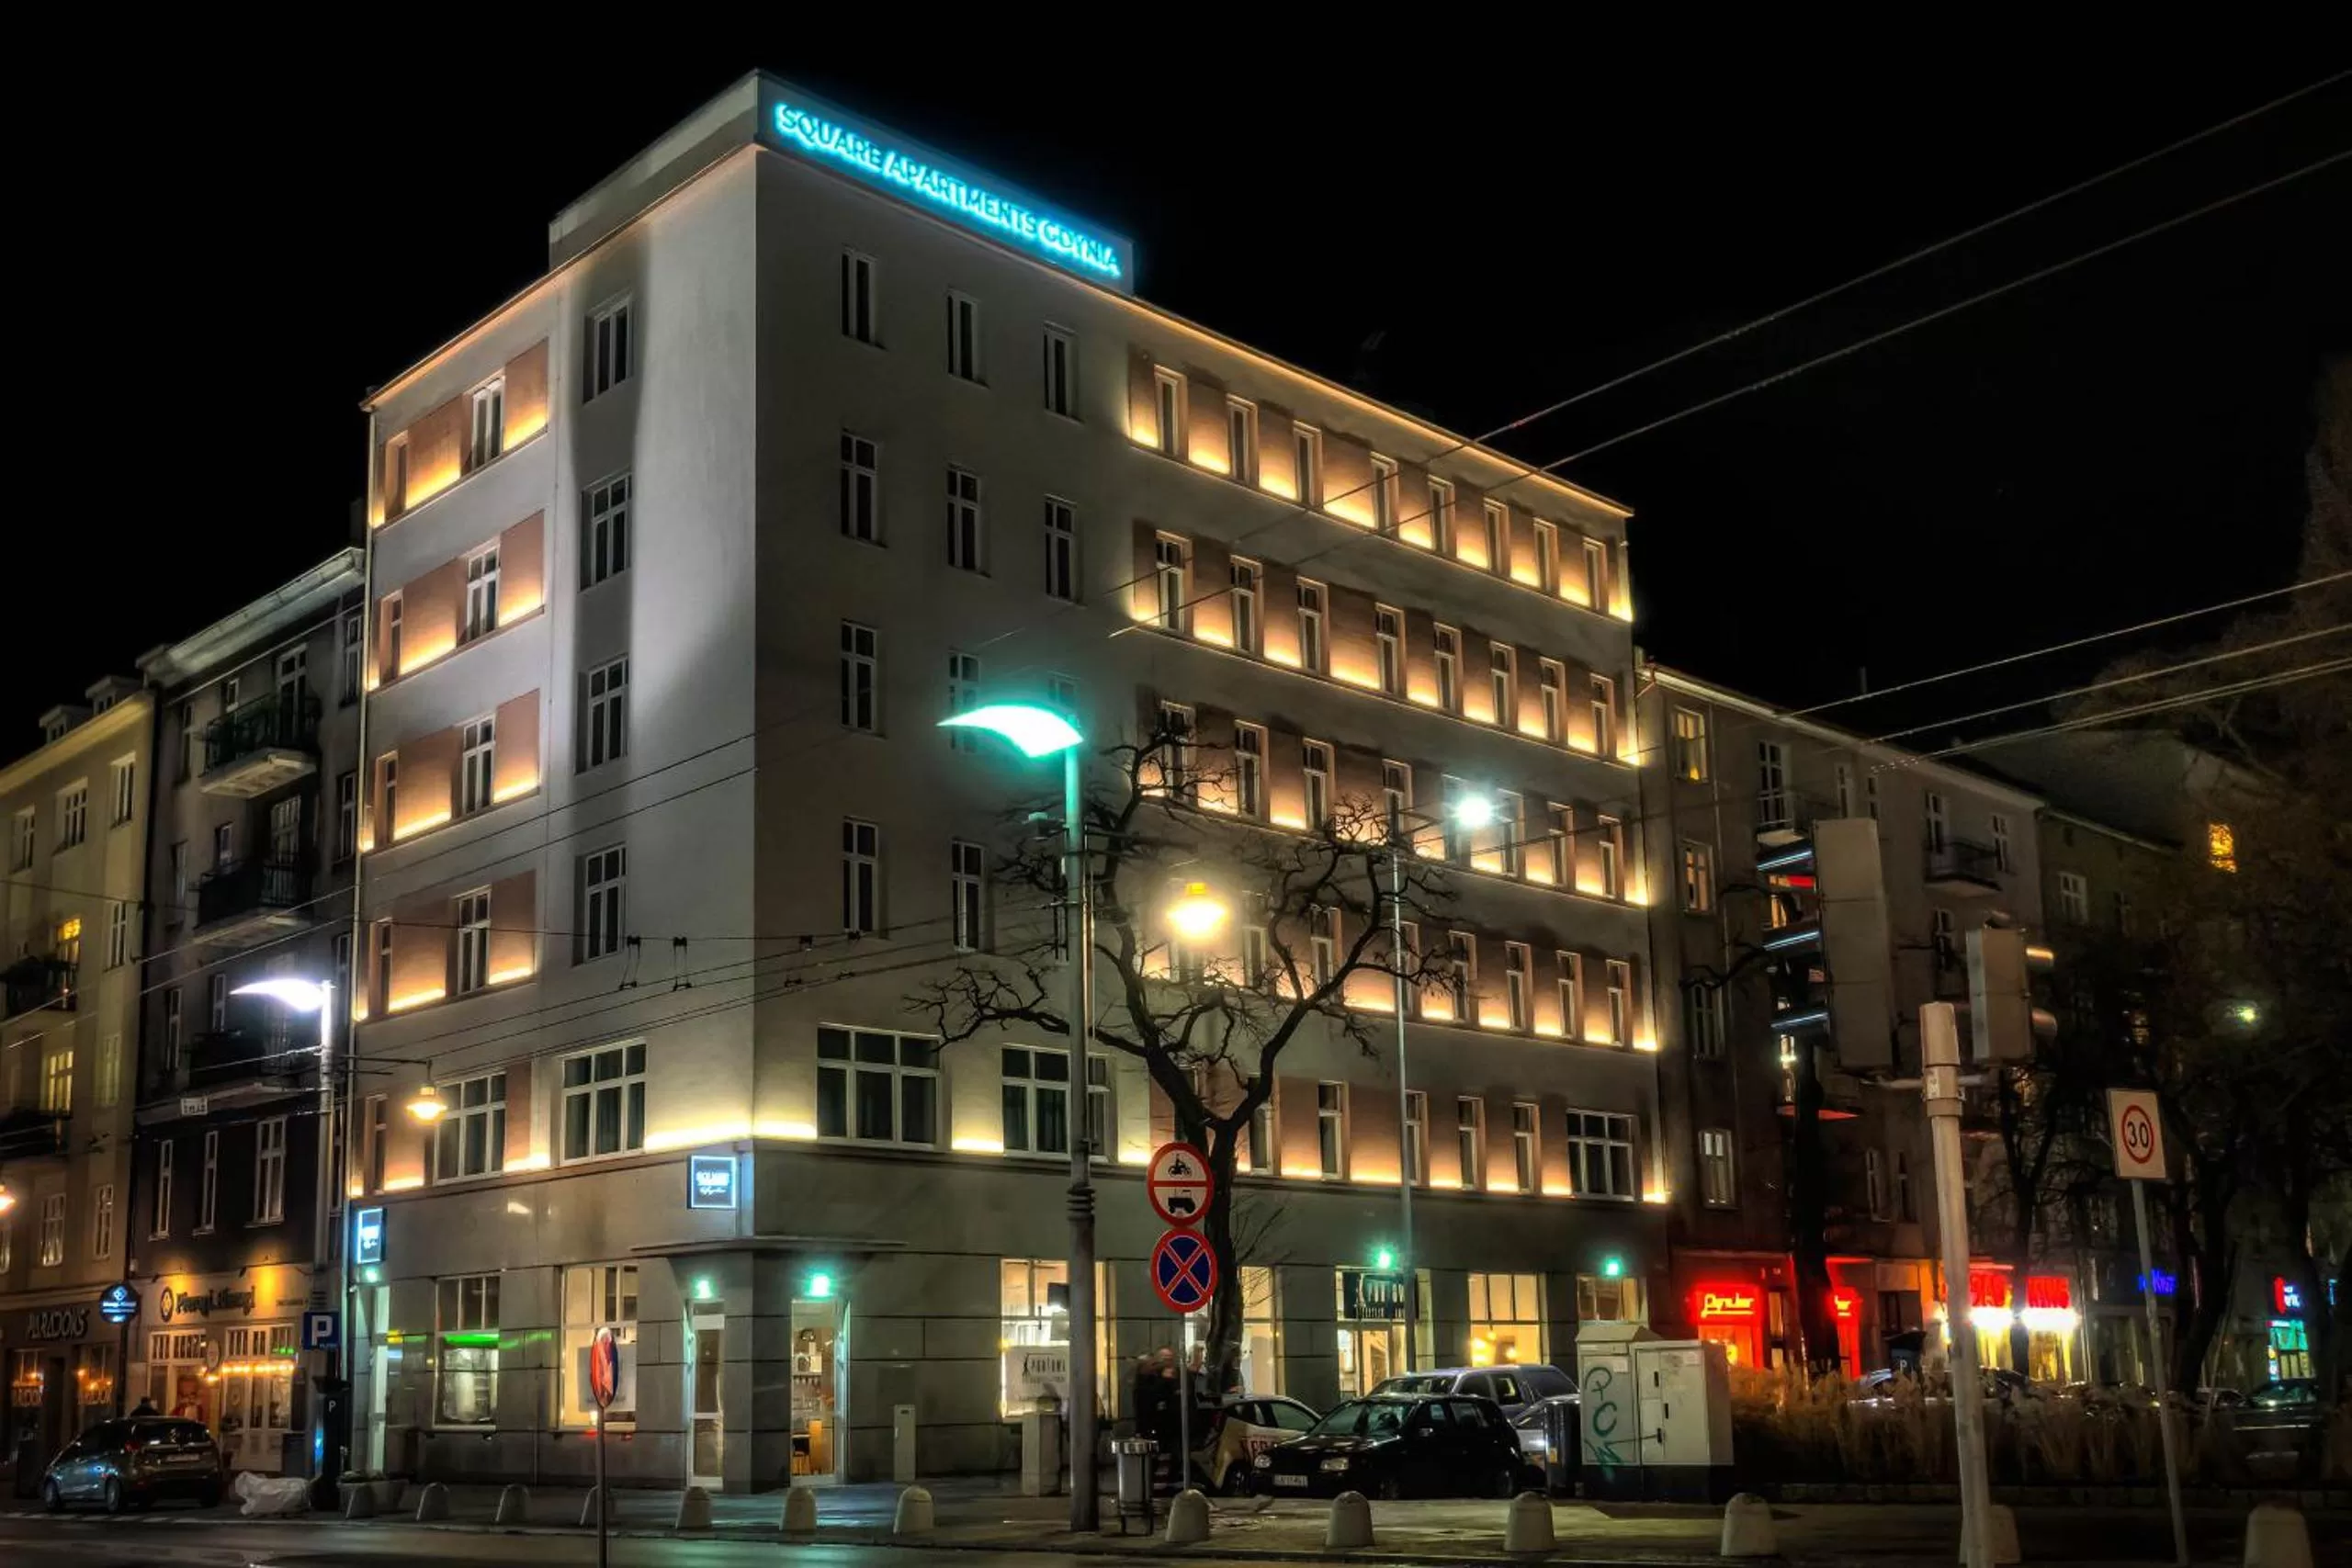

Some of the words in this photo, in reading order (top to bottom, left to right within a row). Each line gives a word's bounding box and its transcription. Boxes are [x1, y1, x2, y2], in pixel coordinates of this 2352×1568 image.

[775, 103, 882, 173] SQUARE
[883, 151, 1036, 238] APARTMENTS
[1037, 218, 1121, 277] GDYNIA
[2127, 1121, 2149, 1149] 30
[311, 1315, 333, 1346] P
[329, 1400, 336, 1413] P
